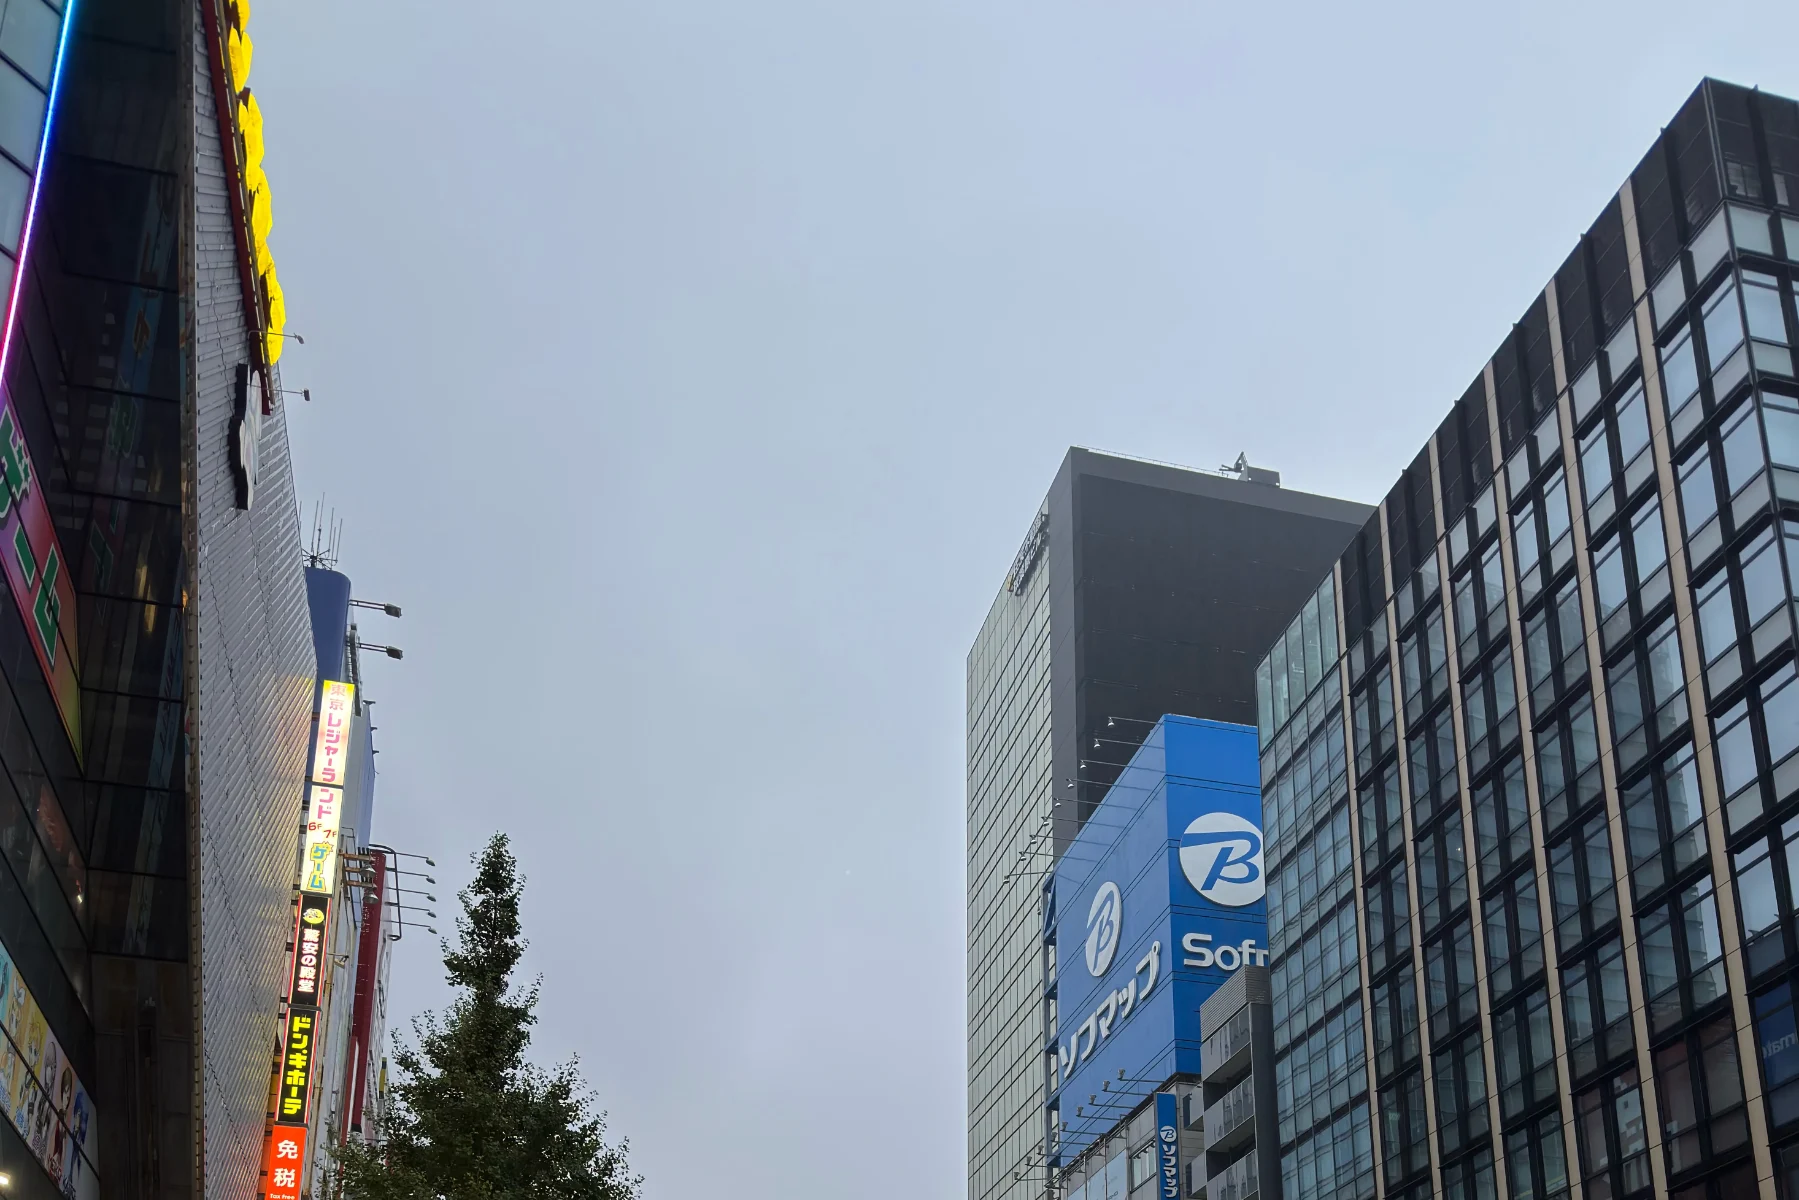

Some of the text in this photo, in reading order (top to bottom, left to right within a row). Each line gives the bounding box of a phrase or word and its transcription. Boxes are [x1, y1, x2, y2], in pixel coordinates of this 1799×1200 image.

[316, 683, 347, 820] 東京レジャーランド
[297, 928, 320, 993] 驚安の殿堂
[1059, 940, 1162, 1079] ソフマップ
[273, 1139, 299, 1188] 免税
[1162, 1144, 1178, 1199] ソフマップ
[281, 1193, 296, 1200] free
